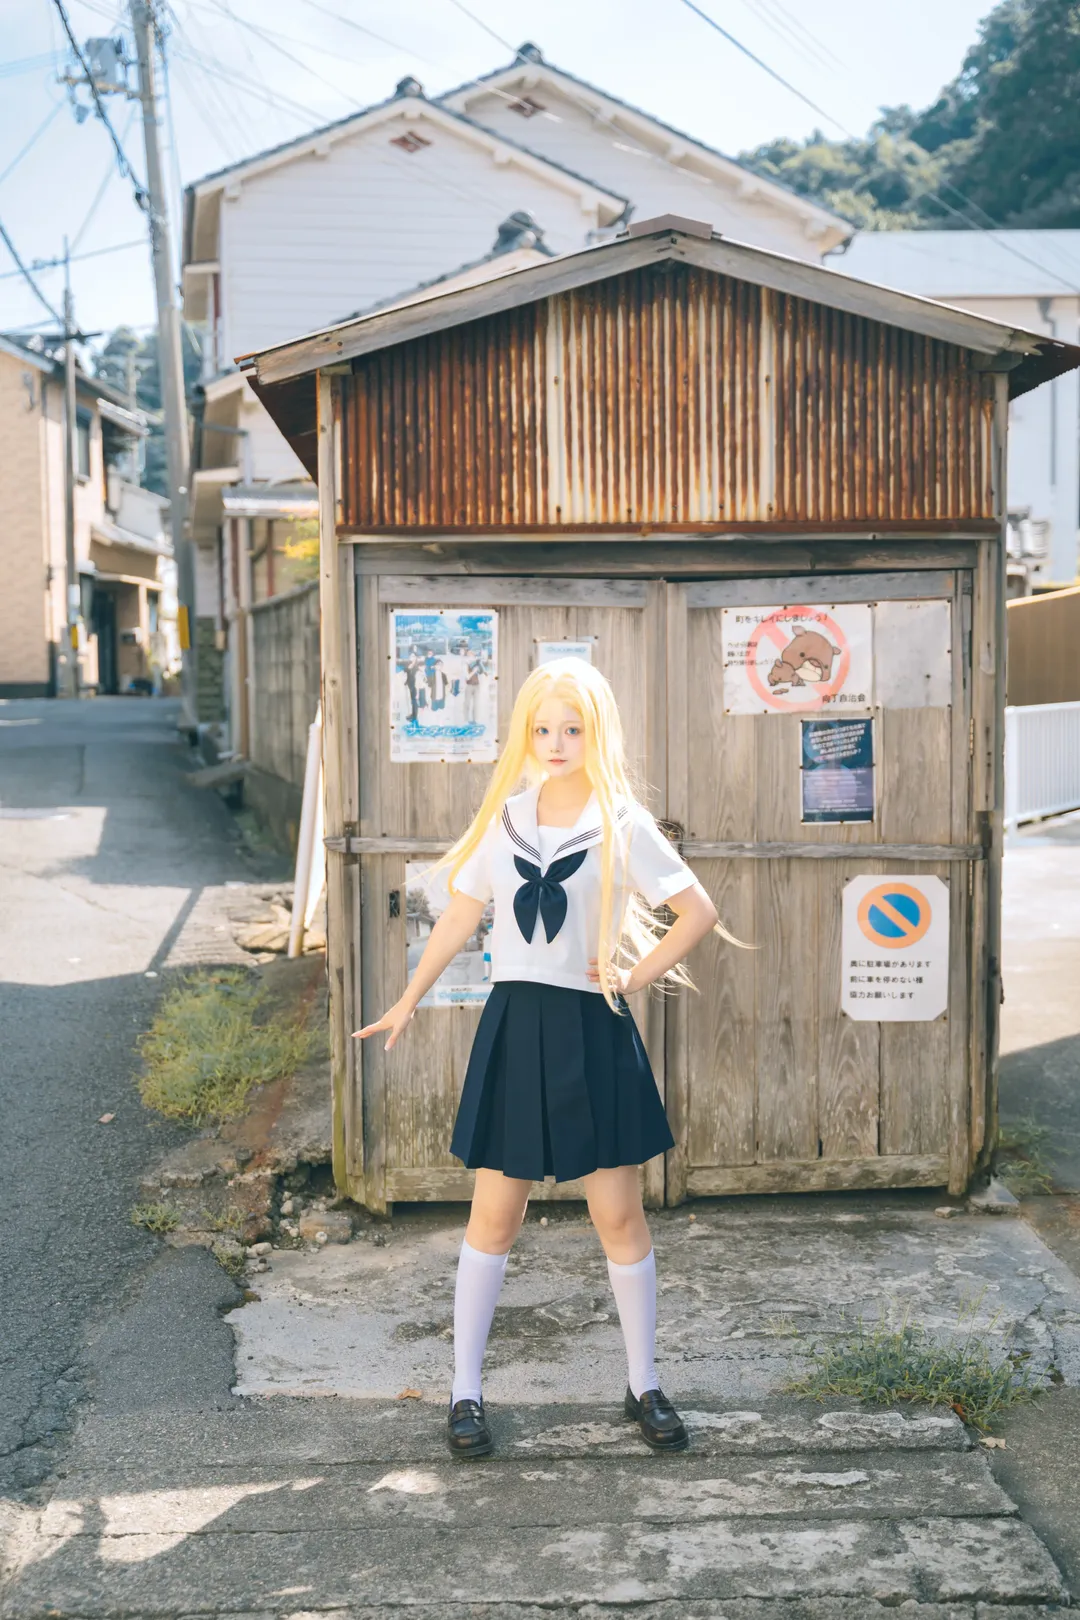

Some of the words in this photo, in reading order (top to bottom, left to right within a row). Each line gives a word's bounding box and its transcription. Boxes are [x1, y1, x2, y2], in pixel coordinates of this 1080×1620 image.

[849, 991, 914, 999] 協力お願いします
